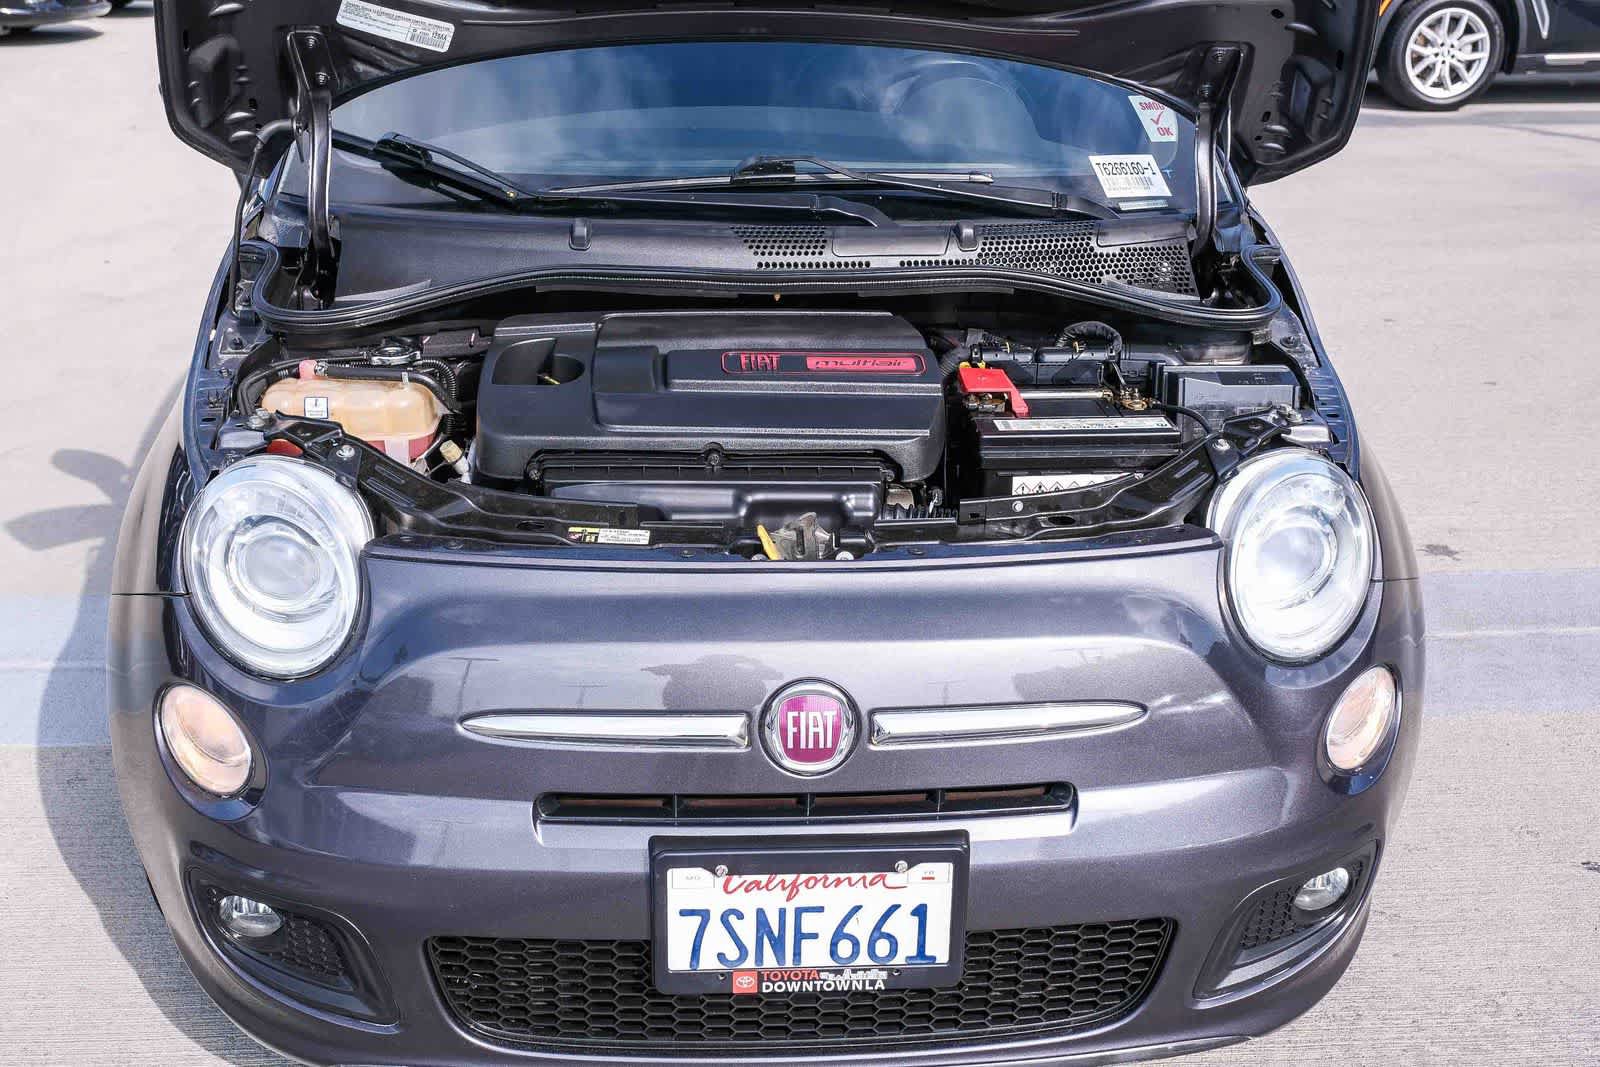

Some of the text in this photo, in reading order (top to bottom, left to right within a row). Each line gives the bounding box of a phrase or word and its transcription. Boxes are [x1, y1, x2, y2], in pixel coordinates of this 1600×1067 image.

[1157, 127, 1173, 136] OK
[739, 352, 781, 370] FIAT
[787, 711, 837, 749] FIAT
[723, 873, 907, 902] California
[679, 903, 937, 970] 7SNF661
[761, 969, 820, 981] TOYOTA
